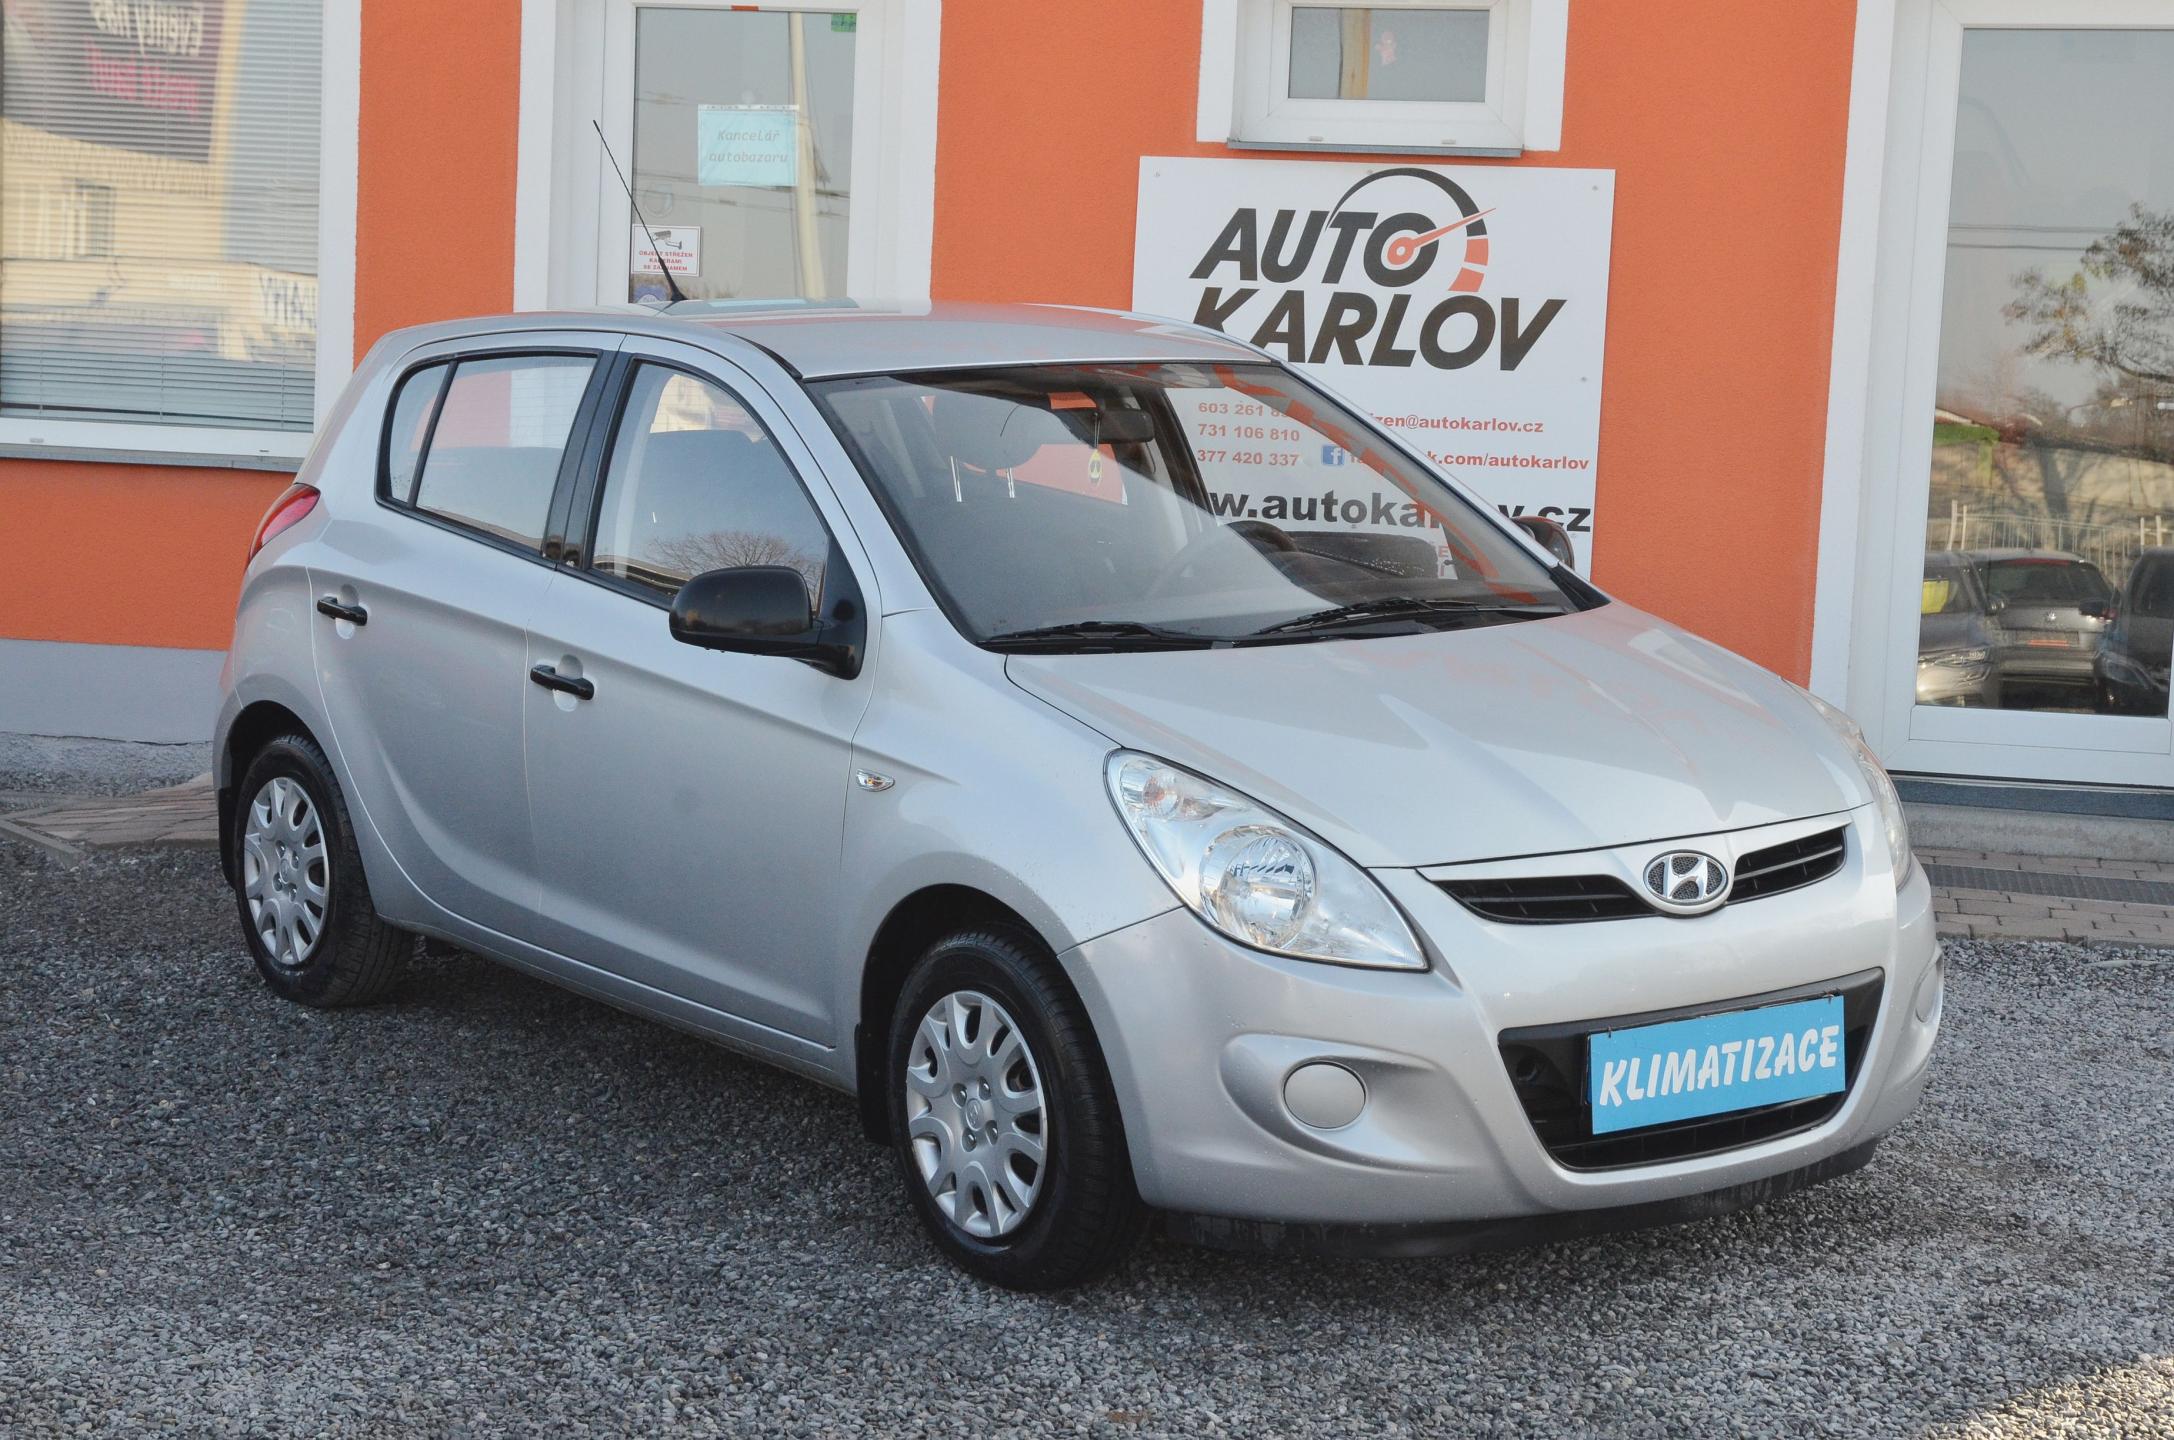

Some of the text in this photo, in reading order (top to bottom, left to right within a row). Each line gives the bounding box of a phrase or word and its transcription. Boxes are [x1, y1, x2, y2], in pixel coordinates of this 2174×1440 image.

[718, 129, 780, 141] Kancelář
[707, 151, 789, 162] autobazaru
[1189, 207, 1440, 288] AUTO
[1193, 286, 1567, 372] KARLOV
[1199, 402, 1228, 414] 603
[1234, 404, 1264, 416] 261
[1198, 424, 1300, 441] 731 106 810
[1198, 450, 1299, 466] 377 420 337
[1600, 1025, 1839, 1107] KLIMATIZACE
